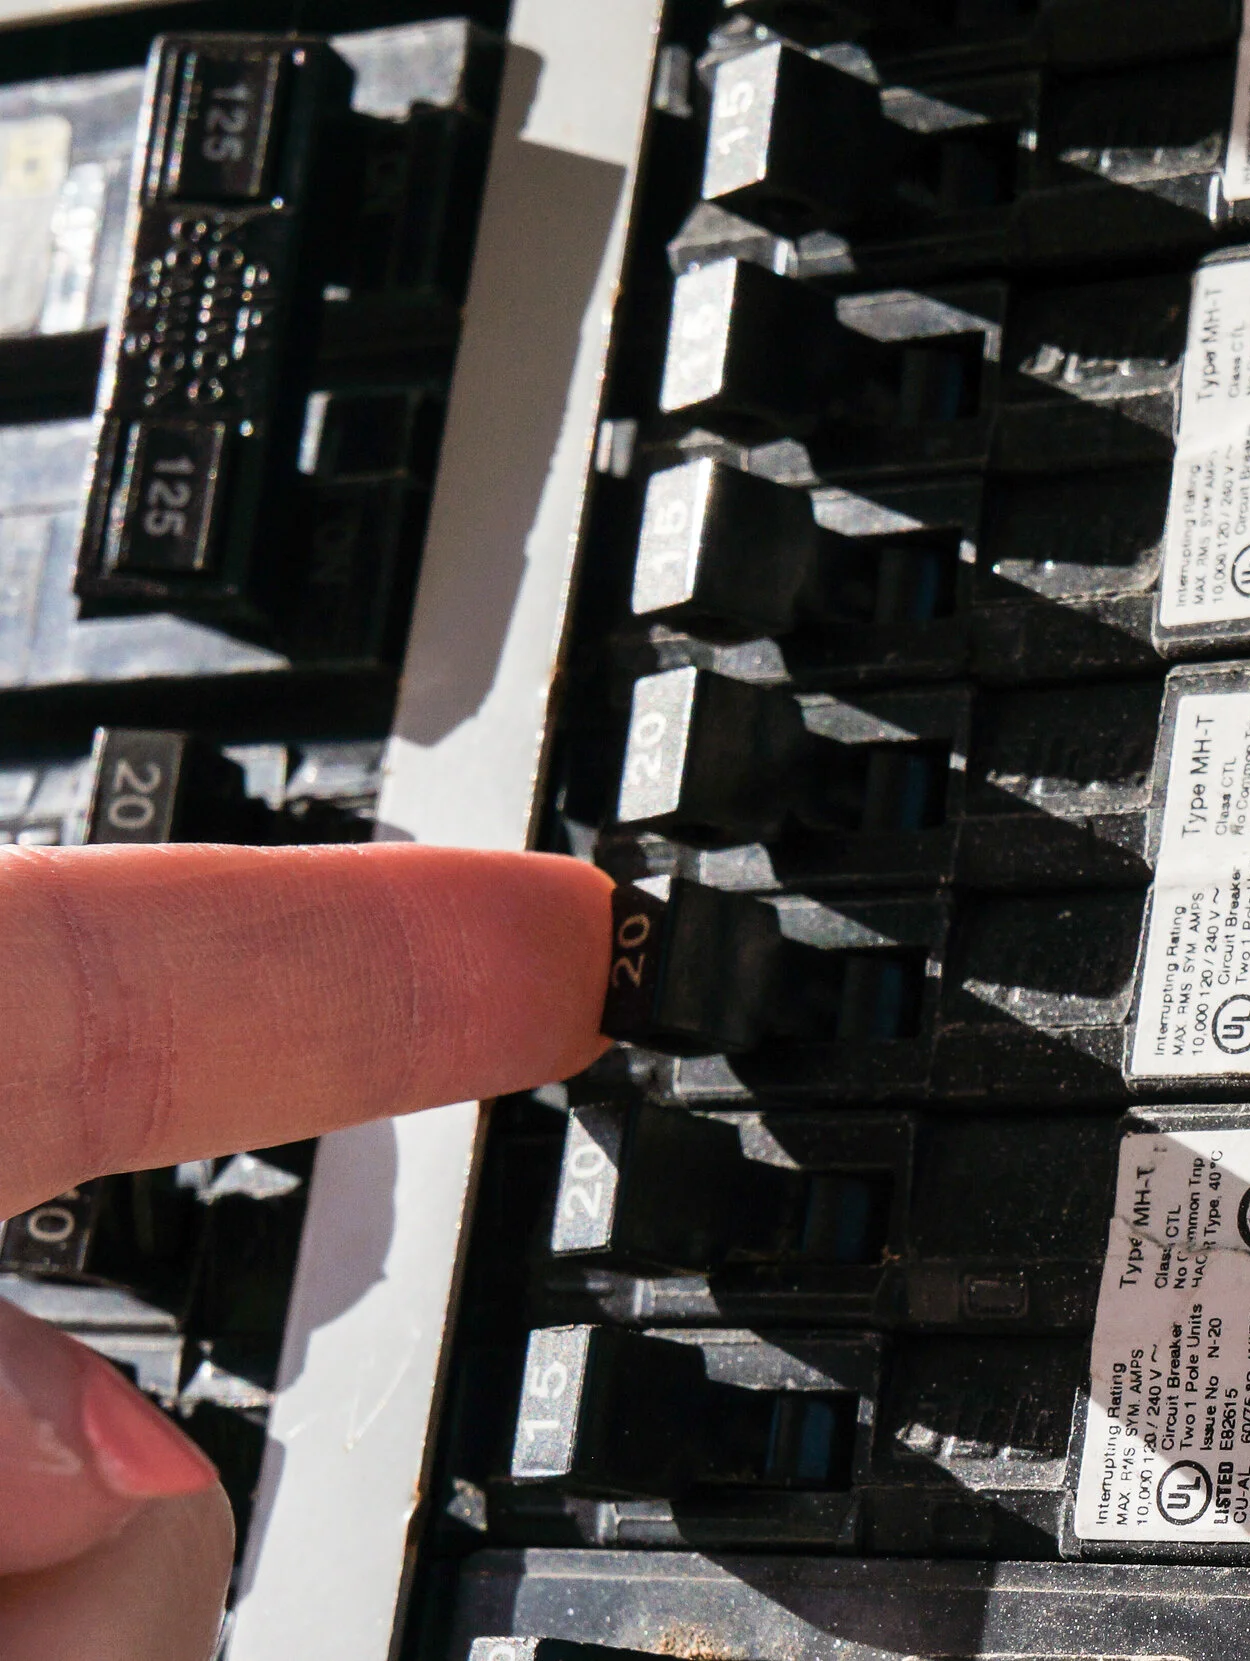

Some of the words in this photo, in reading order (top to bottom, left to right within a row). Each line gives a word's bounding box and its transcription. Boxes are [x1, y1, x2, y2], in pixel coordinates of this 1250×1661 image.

[203, 83, 250, 161] 125
[715, 81, 755, 155] 15
[143, 456, 196, 536] 125
[1234, 485, 1250, 535] Circuit
[653, 500, 687, 572] 15
[1176, 518, 1196, 606] Interrupting
[630, 712, 667, 785] 20
[1189, 714, 1214, 774] MH-T
[1220, 756, 1236, 788] CTL
[108, 759, 161, 830] 20
[1181, 783, 1208, 837] Type
[1215, 793, 1231, 835] Class
[612, 912, 650, 988] 20
[1165, 905, 1186, 956] Rating
[1203, 925, 1219, 953] 240
[1199, 969, 1213, 996] 120
[1217, 933, 1235, 985] Circuit
[1234, 951, 1250, 984] Two
[1154, 962, 1179, 1055] Interrupting
[1191, 1003, 1209, 1055] 10,000
[563, 1142, 607, 1218] 20
[1131, 1166, 1155, 1226] MH-T
[1208, 1171, 1221, 1190] 40
[1165, 1204, 1181, 1237] CTL
[1173, 1266, 1187, 1289] No
[1186, 1303, 1202, 1347] Units
[1206, 1317, 1222, 1358] N-20
[1128, 1348, 1144, 1394] AMPS
[1166, 1321, 1182, 1387] Breaker
[1184, 1353, 1199, 1392] Pole
[522, 1360, 568, 1443] 15
[1107, 1362, 1127, 1418] Rating
[1160, 1394, 1179, 1450] Circuit
[1179, 1413, 1196, 1450] Two
[1199, 1405, 1216, 1450] Issue
[1218, 1388, 1238, 1450] E82615
[1095, 1425, 1121, 1524] Interrupting
[1136, 1469, 1152, 1525] 10,000
[1146, 1385, 1161, 1416] 240
[1213, 1461, 1234, 1524] LISTED
[1233, 1465, 1250, 1523] CU-AL
